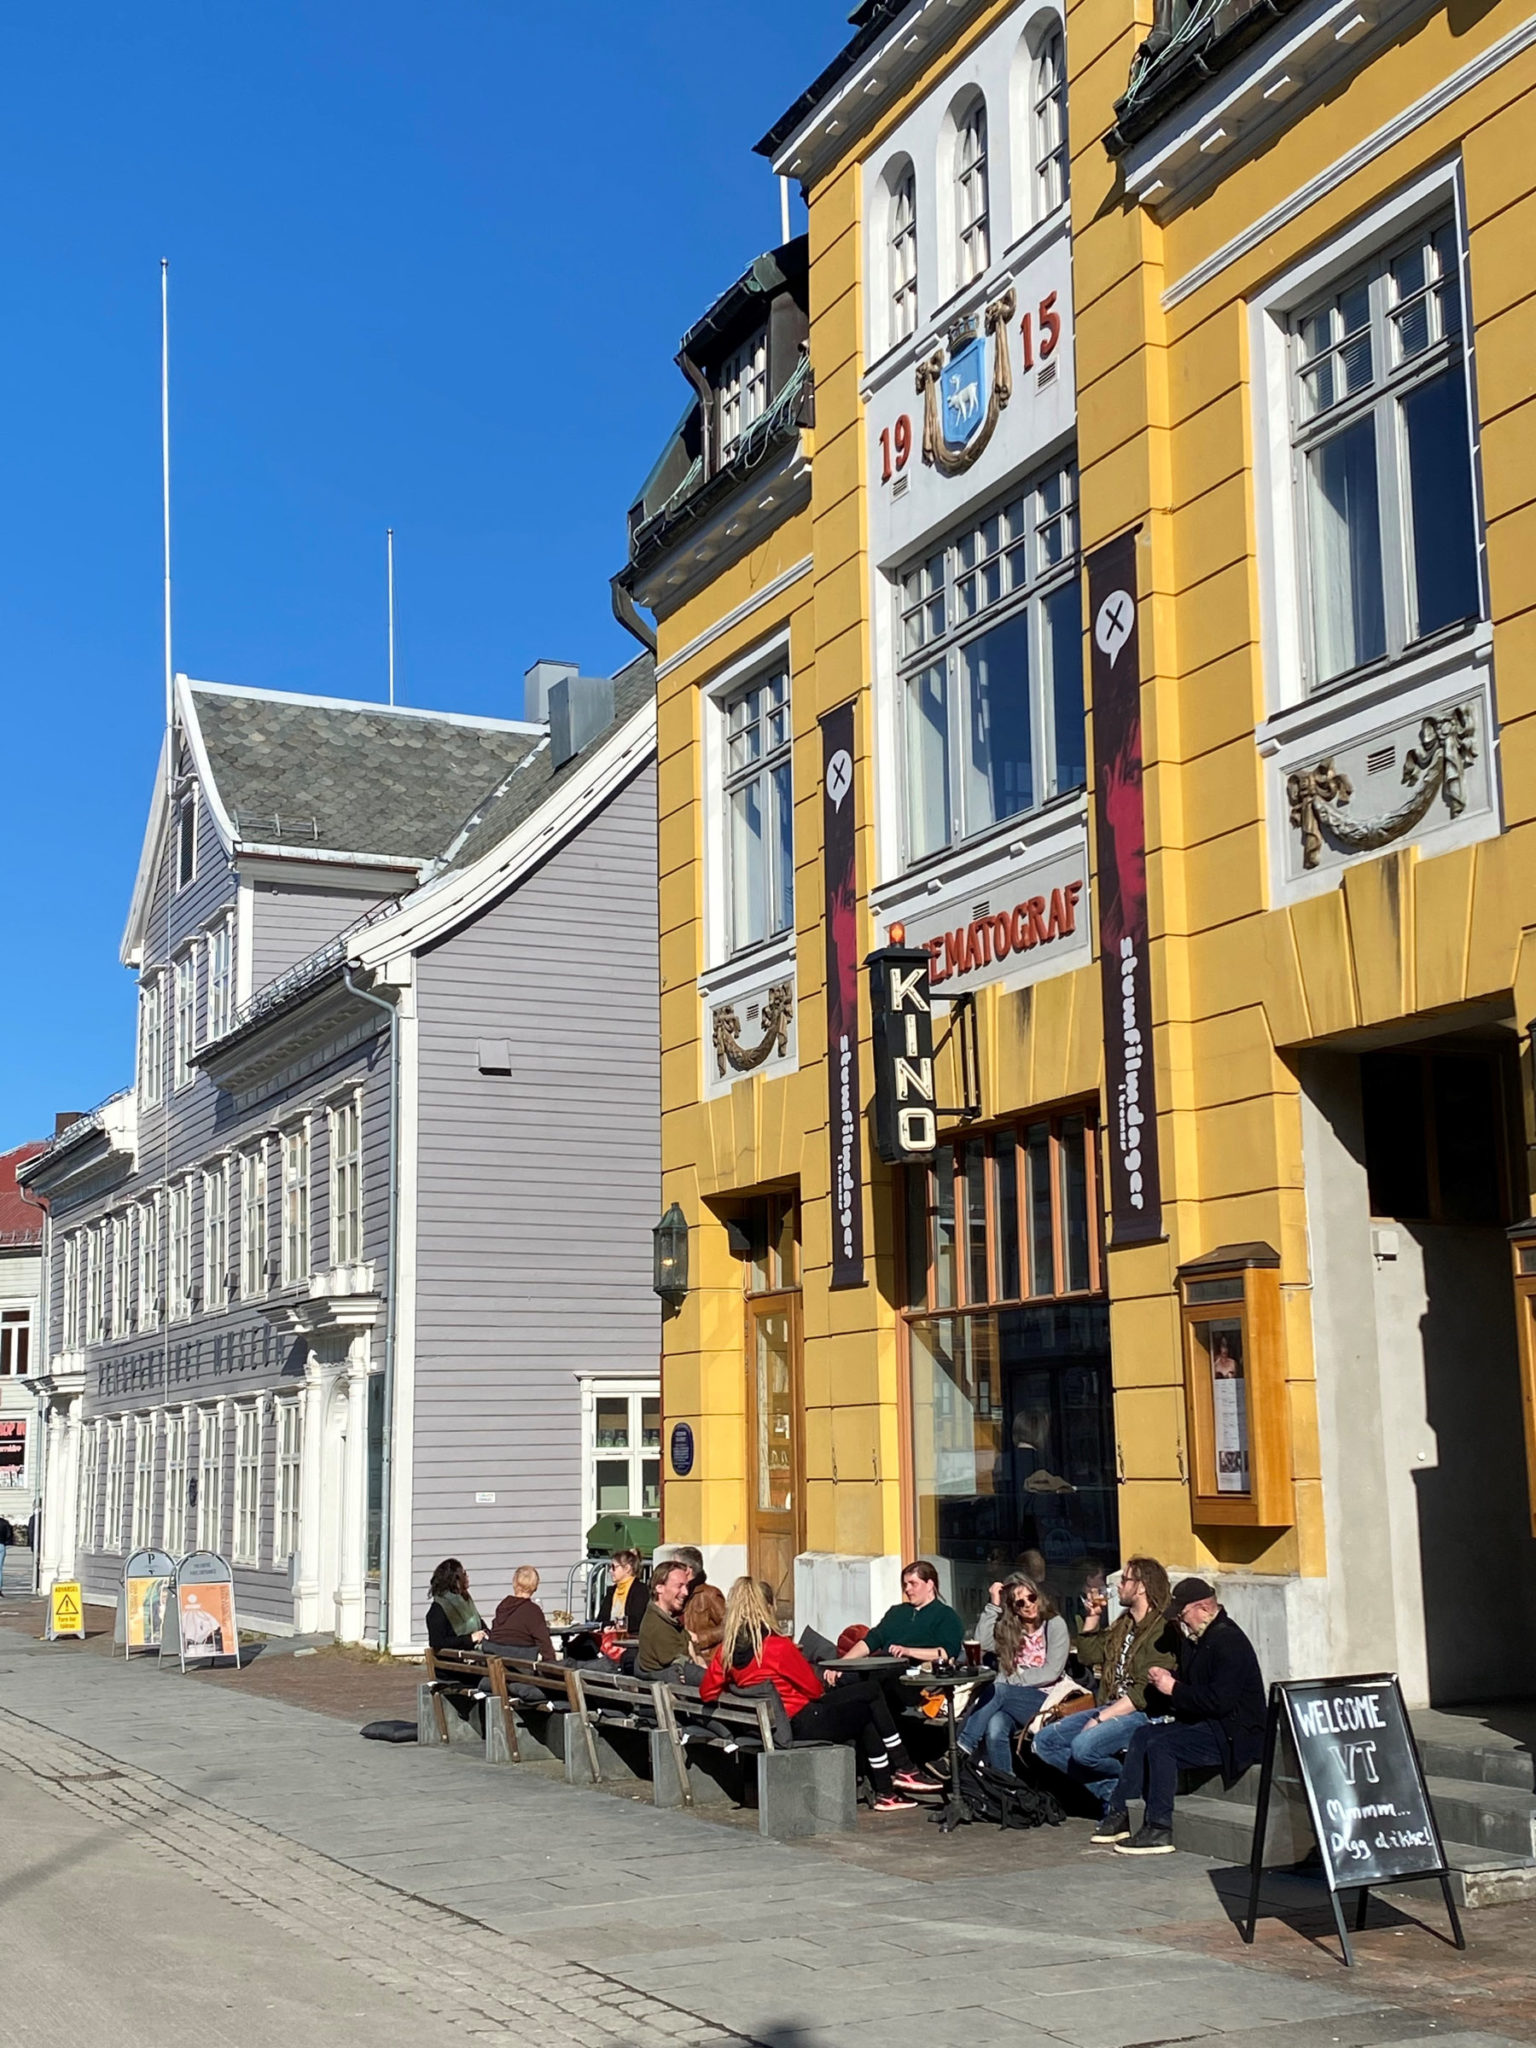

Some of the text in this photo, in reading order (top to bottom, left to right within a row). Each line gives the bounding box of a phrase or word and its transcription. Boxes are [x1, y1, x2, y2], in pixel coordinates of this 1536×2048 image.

[1020, 290, 1061, 374] 15
[879, 414, 912, 486] 19
[918, 880, 1082, 986] EMATOGRAF
[890, 968, 937, 1151] KINO
[1294, 1694, 1386, 1737] WELCOME
